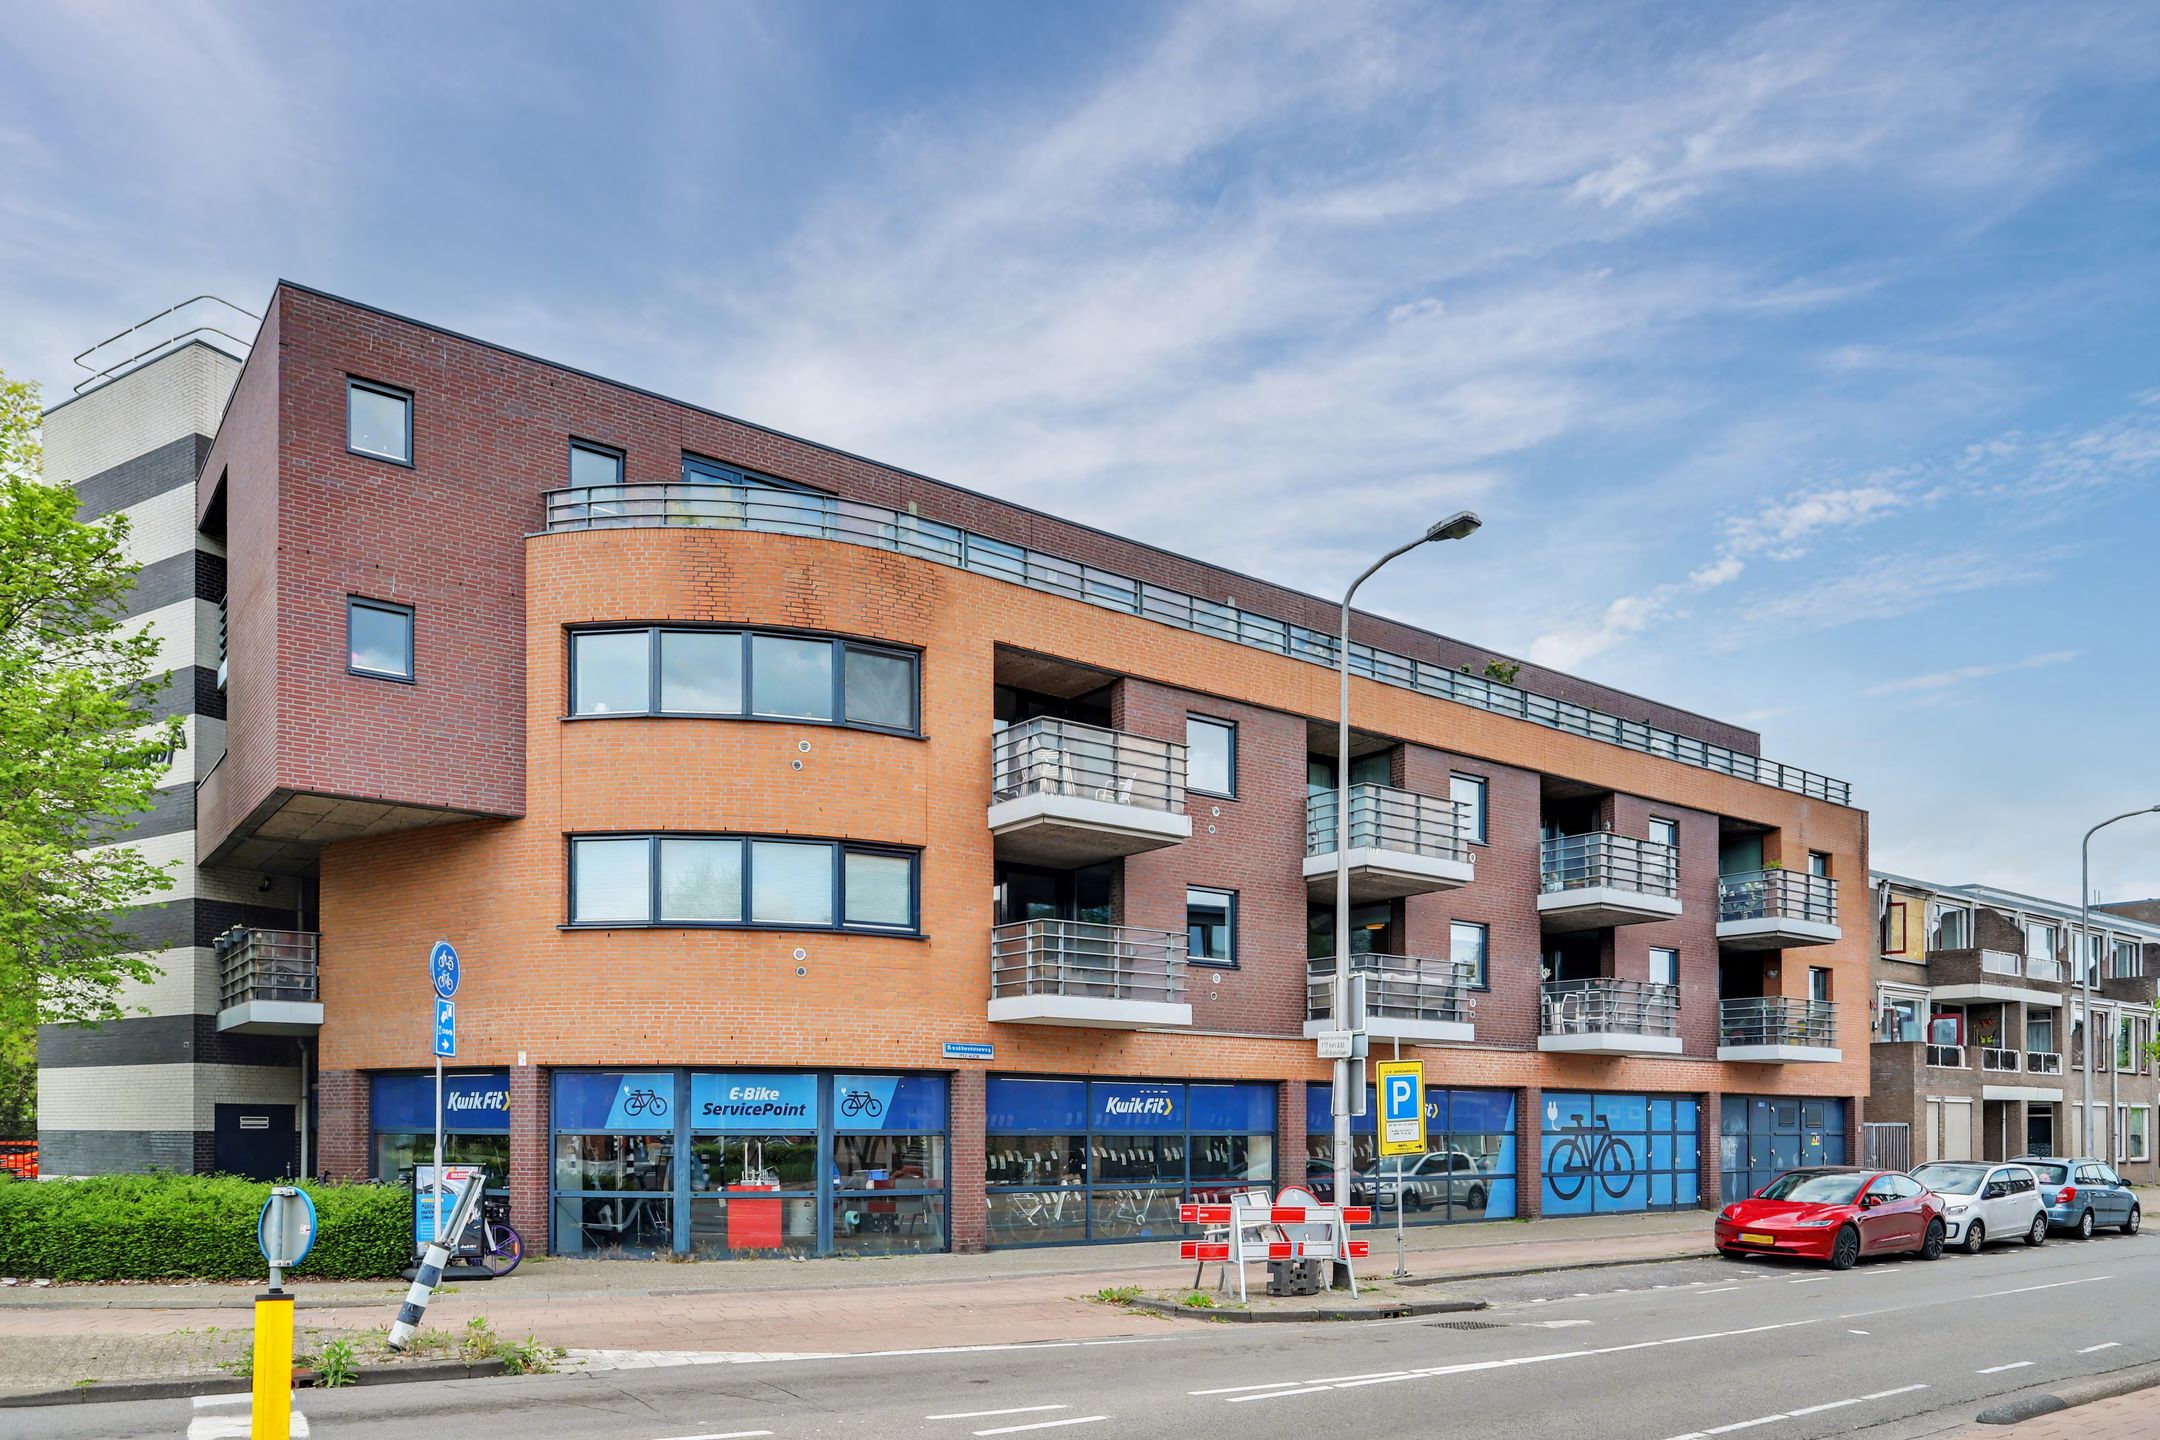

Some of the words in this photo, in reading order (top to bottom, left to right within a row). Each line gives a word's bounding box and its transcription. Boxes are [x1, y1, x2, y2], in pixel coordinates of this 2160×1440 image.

[729, 1087, 780, 1101] E-Bike
[1392, 1080, 1411, 1115] P
[702, 1103, 806, 1116] ServicePoint
